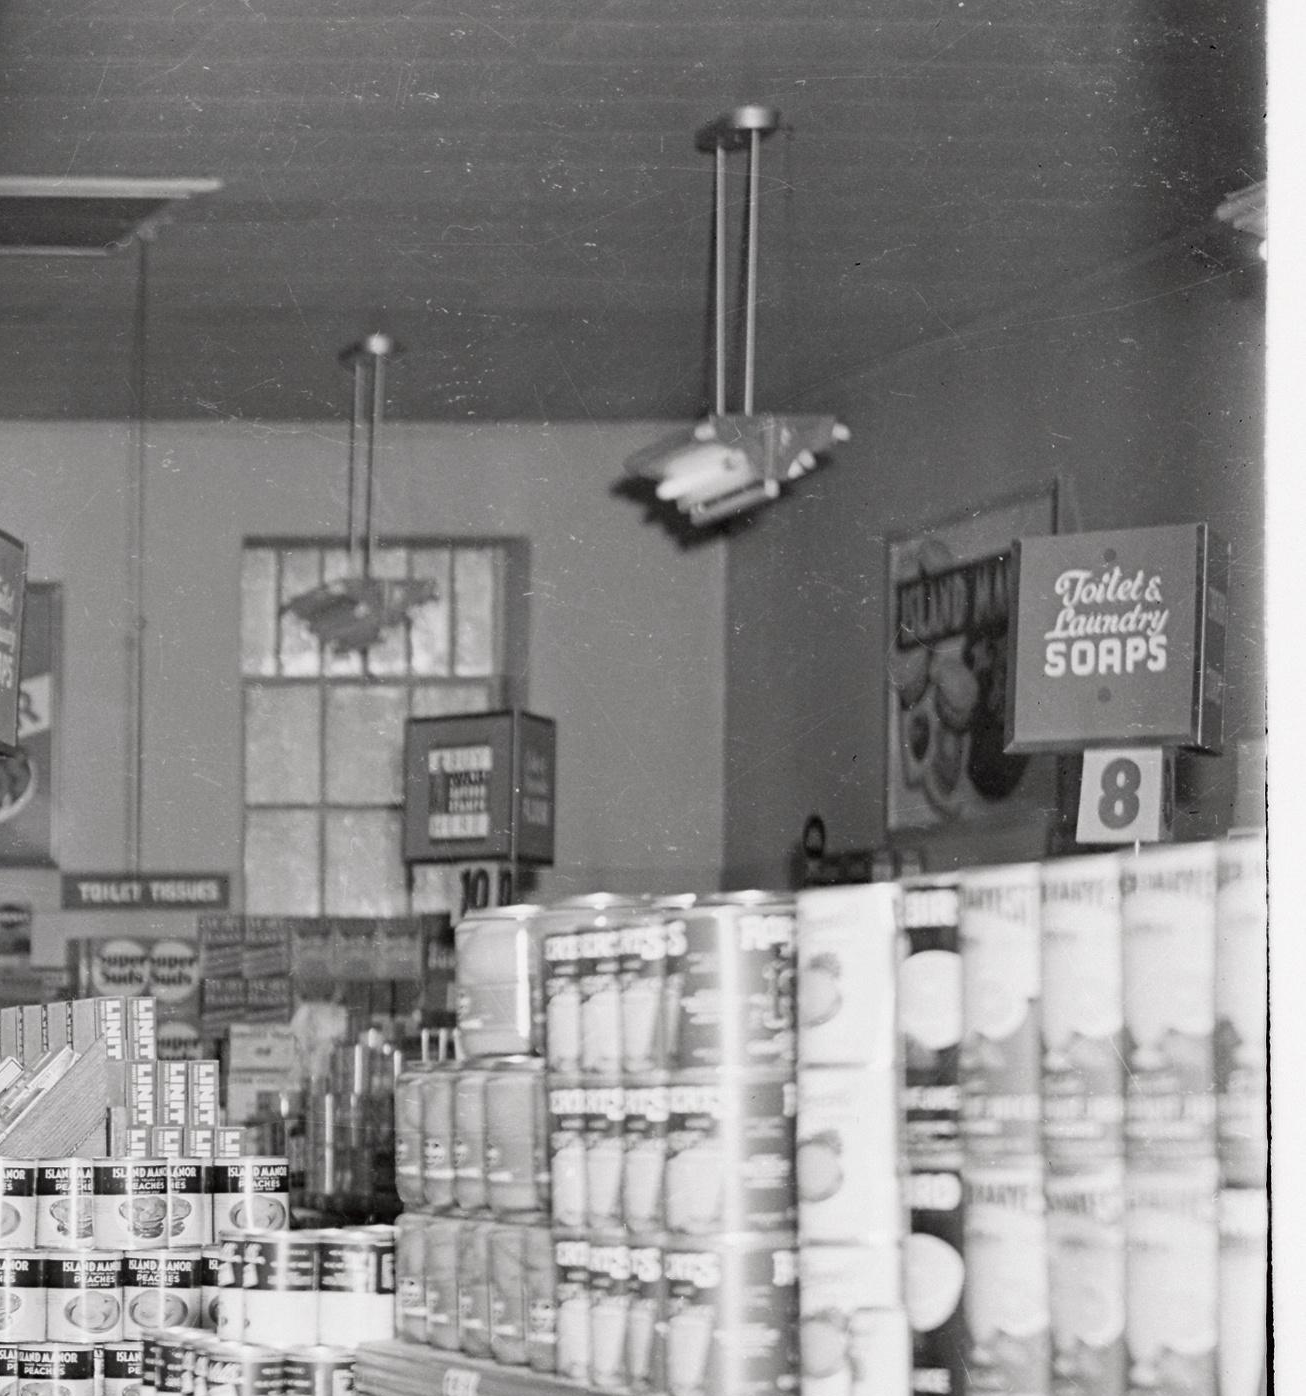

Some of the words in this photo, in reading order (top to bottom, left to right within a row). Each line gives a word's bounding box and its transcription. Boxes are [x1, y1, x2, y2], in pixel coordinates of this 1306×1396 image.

[1054, 566, 1142, 609] Toilet
[1145, 572, 1163, 602] &
[1044, 606, 1169, 641] Laundry
[1044, 636, 1168, 678] SOAPS
[1097, 757, 1142, 830] 8
[78, 882, 142, 902] TOILET
[150, 882, 221, 902] TISSUES
[106, 999, 122, 1060] LINIT
[139, 999, 155, 1060] LINIT
[137, 1063, 154, 1125] LINIT
[170, 1062, 186, 1125] LINIT
[199, 1063, 215, 1126] LINIT
[116, 1352, 142, 1362] ISLAN
